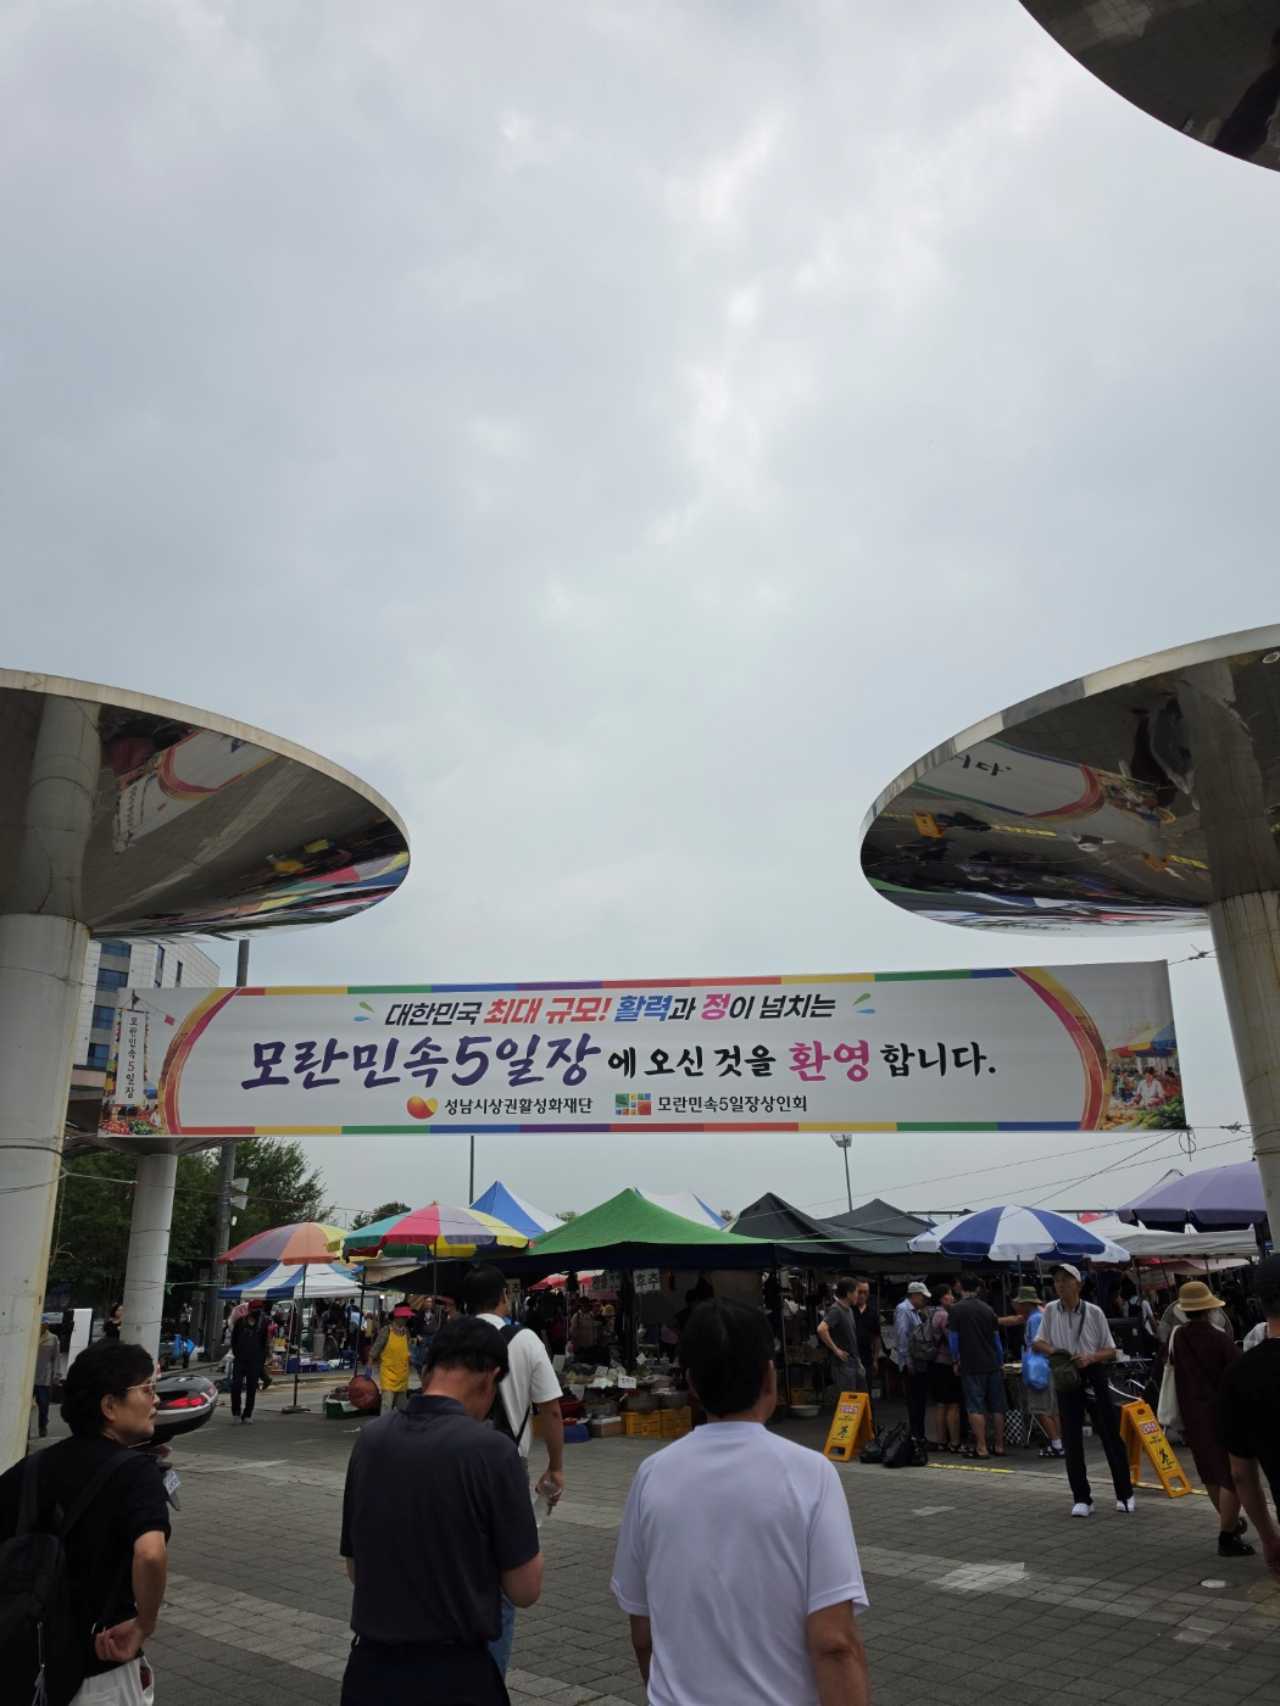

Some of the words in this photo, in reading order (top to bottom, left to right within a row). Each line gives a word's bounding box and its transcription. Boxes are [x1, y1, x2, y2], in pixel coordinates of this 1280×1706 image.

[385, 1001, 483, 1026] 대한민국
[484, 997, 541, 1025] 최대
[545, 996, 611, 1024] 규모!
[614, 995, 697, 1022] 활력과
[700, 993, 754, 1020] 정이
[760, 993, 836, 1020] 넘치는
[241, 1033, 601, 1088] 모란민속5일장
[715, 1044, 777, 1078] 것을
[789, 1039, 871, 1083] 환영
[881, 1041, 997, 1079] 합니다.
[444, 1097, 592, 1116] 성남시상권활성화재단
[657, 1094, 807, 1114] 모란민속5일장상인회
